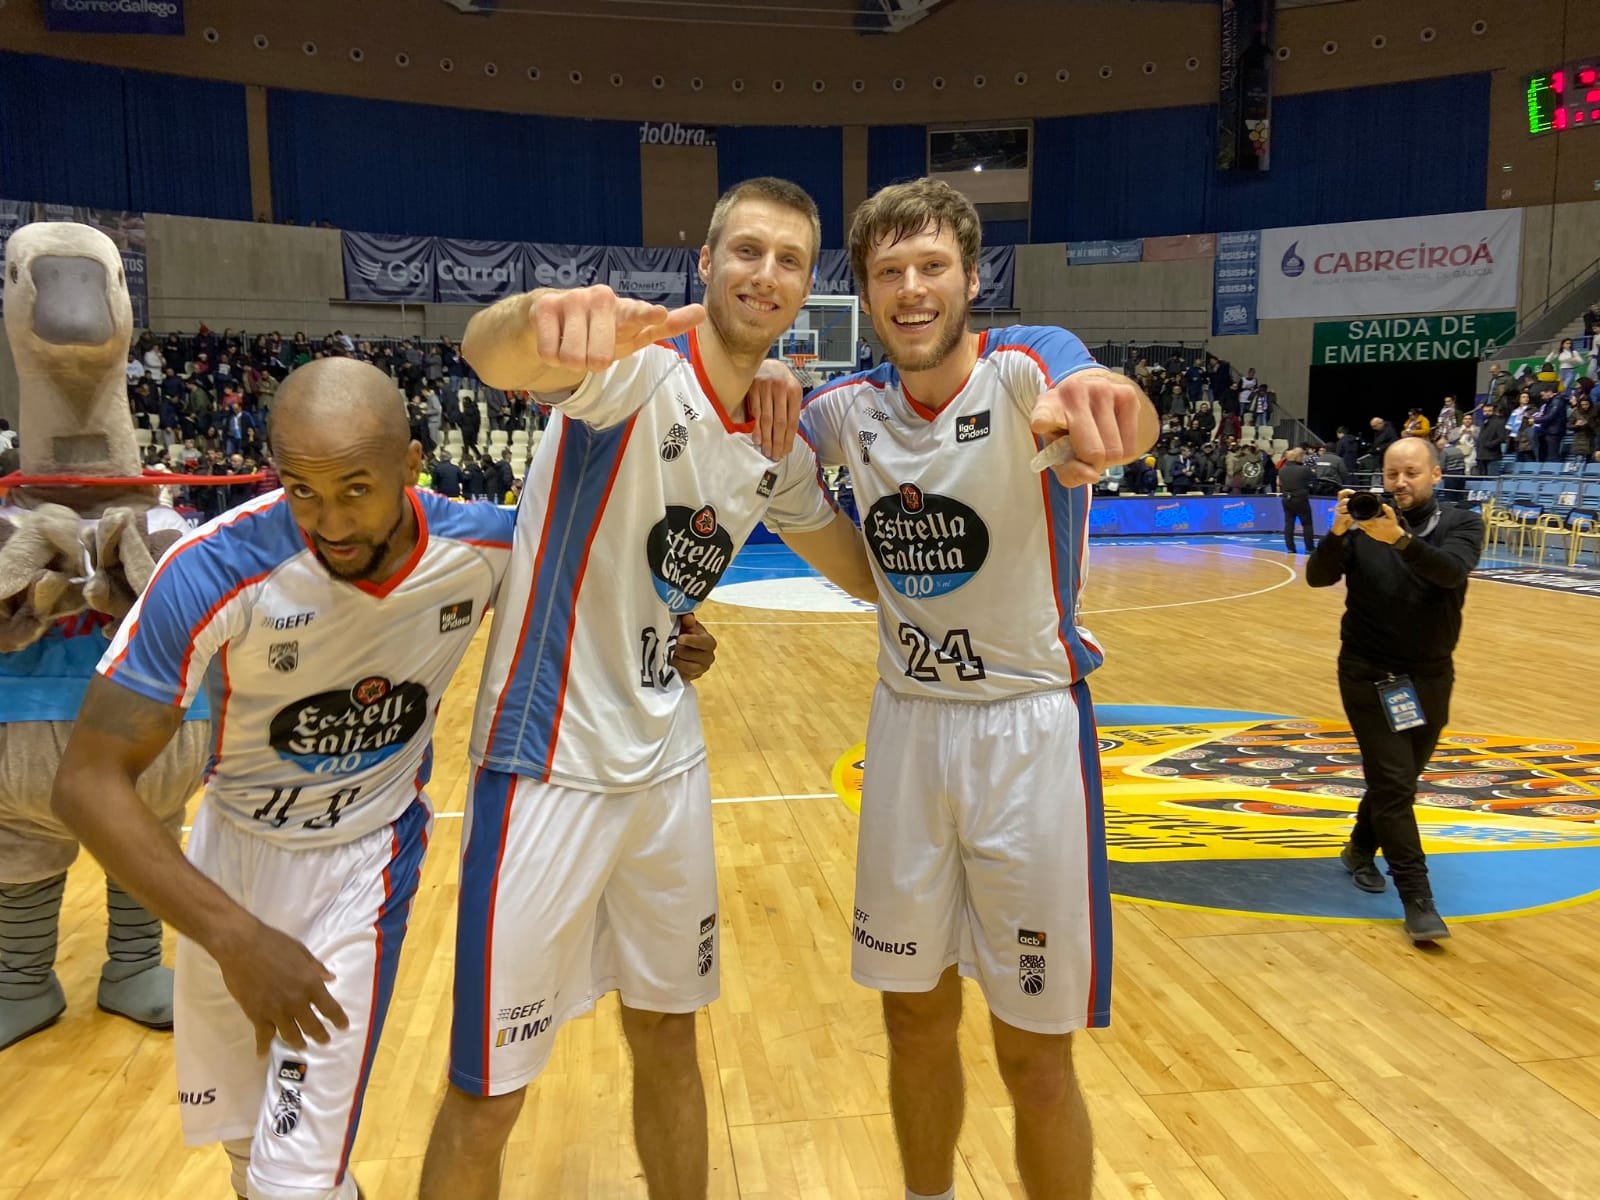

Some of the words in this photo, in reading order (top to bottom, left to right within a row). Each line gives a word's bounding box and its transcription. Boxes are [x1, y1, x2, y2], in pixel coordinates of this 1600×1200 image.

[387, 261, 429, 284] GSI
[437, 259, 516, 283] Carral
[1348, 318, 1431, 340] SAIDA
[1441, 315, 1476, 336] DE
[1324, 338, 1499, 365] EMERXENCIA
[873, 510, 967, 541] Estrella
[879, 541, 965, 571] Galicia
[275, 611, 316, 630] GEFF
[899, 622, 986, 682] 24
[854, 906, 870, 924] EFF
[1020, 936, 1040, 946] acb
[509, 999, 546, 1020] GEFF
